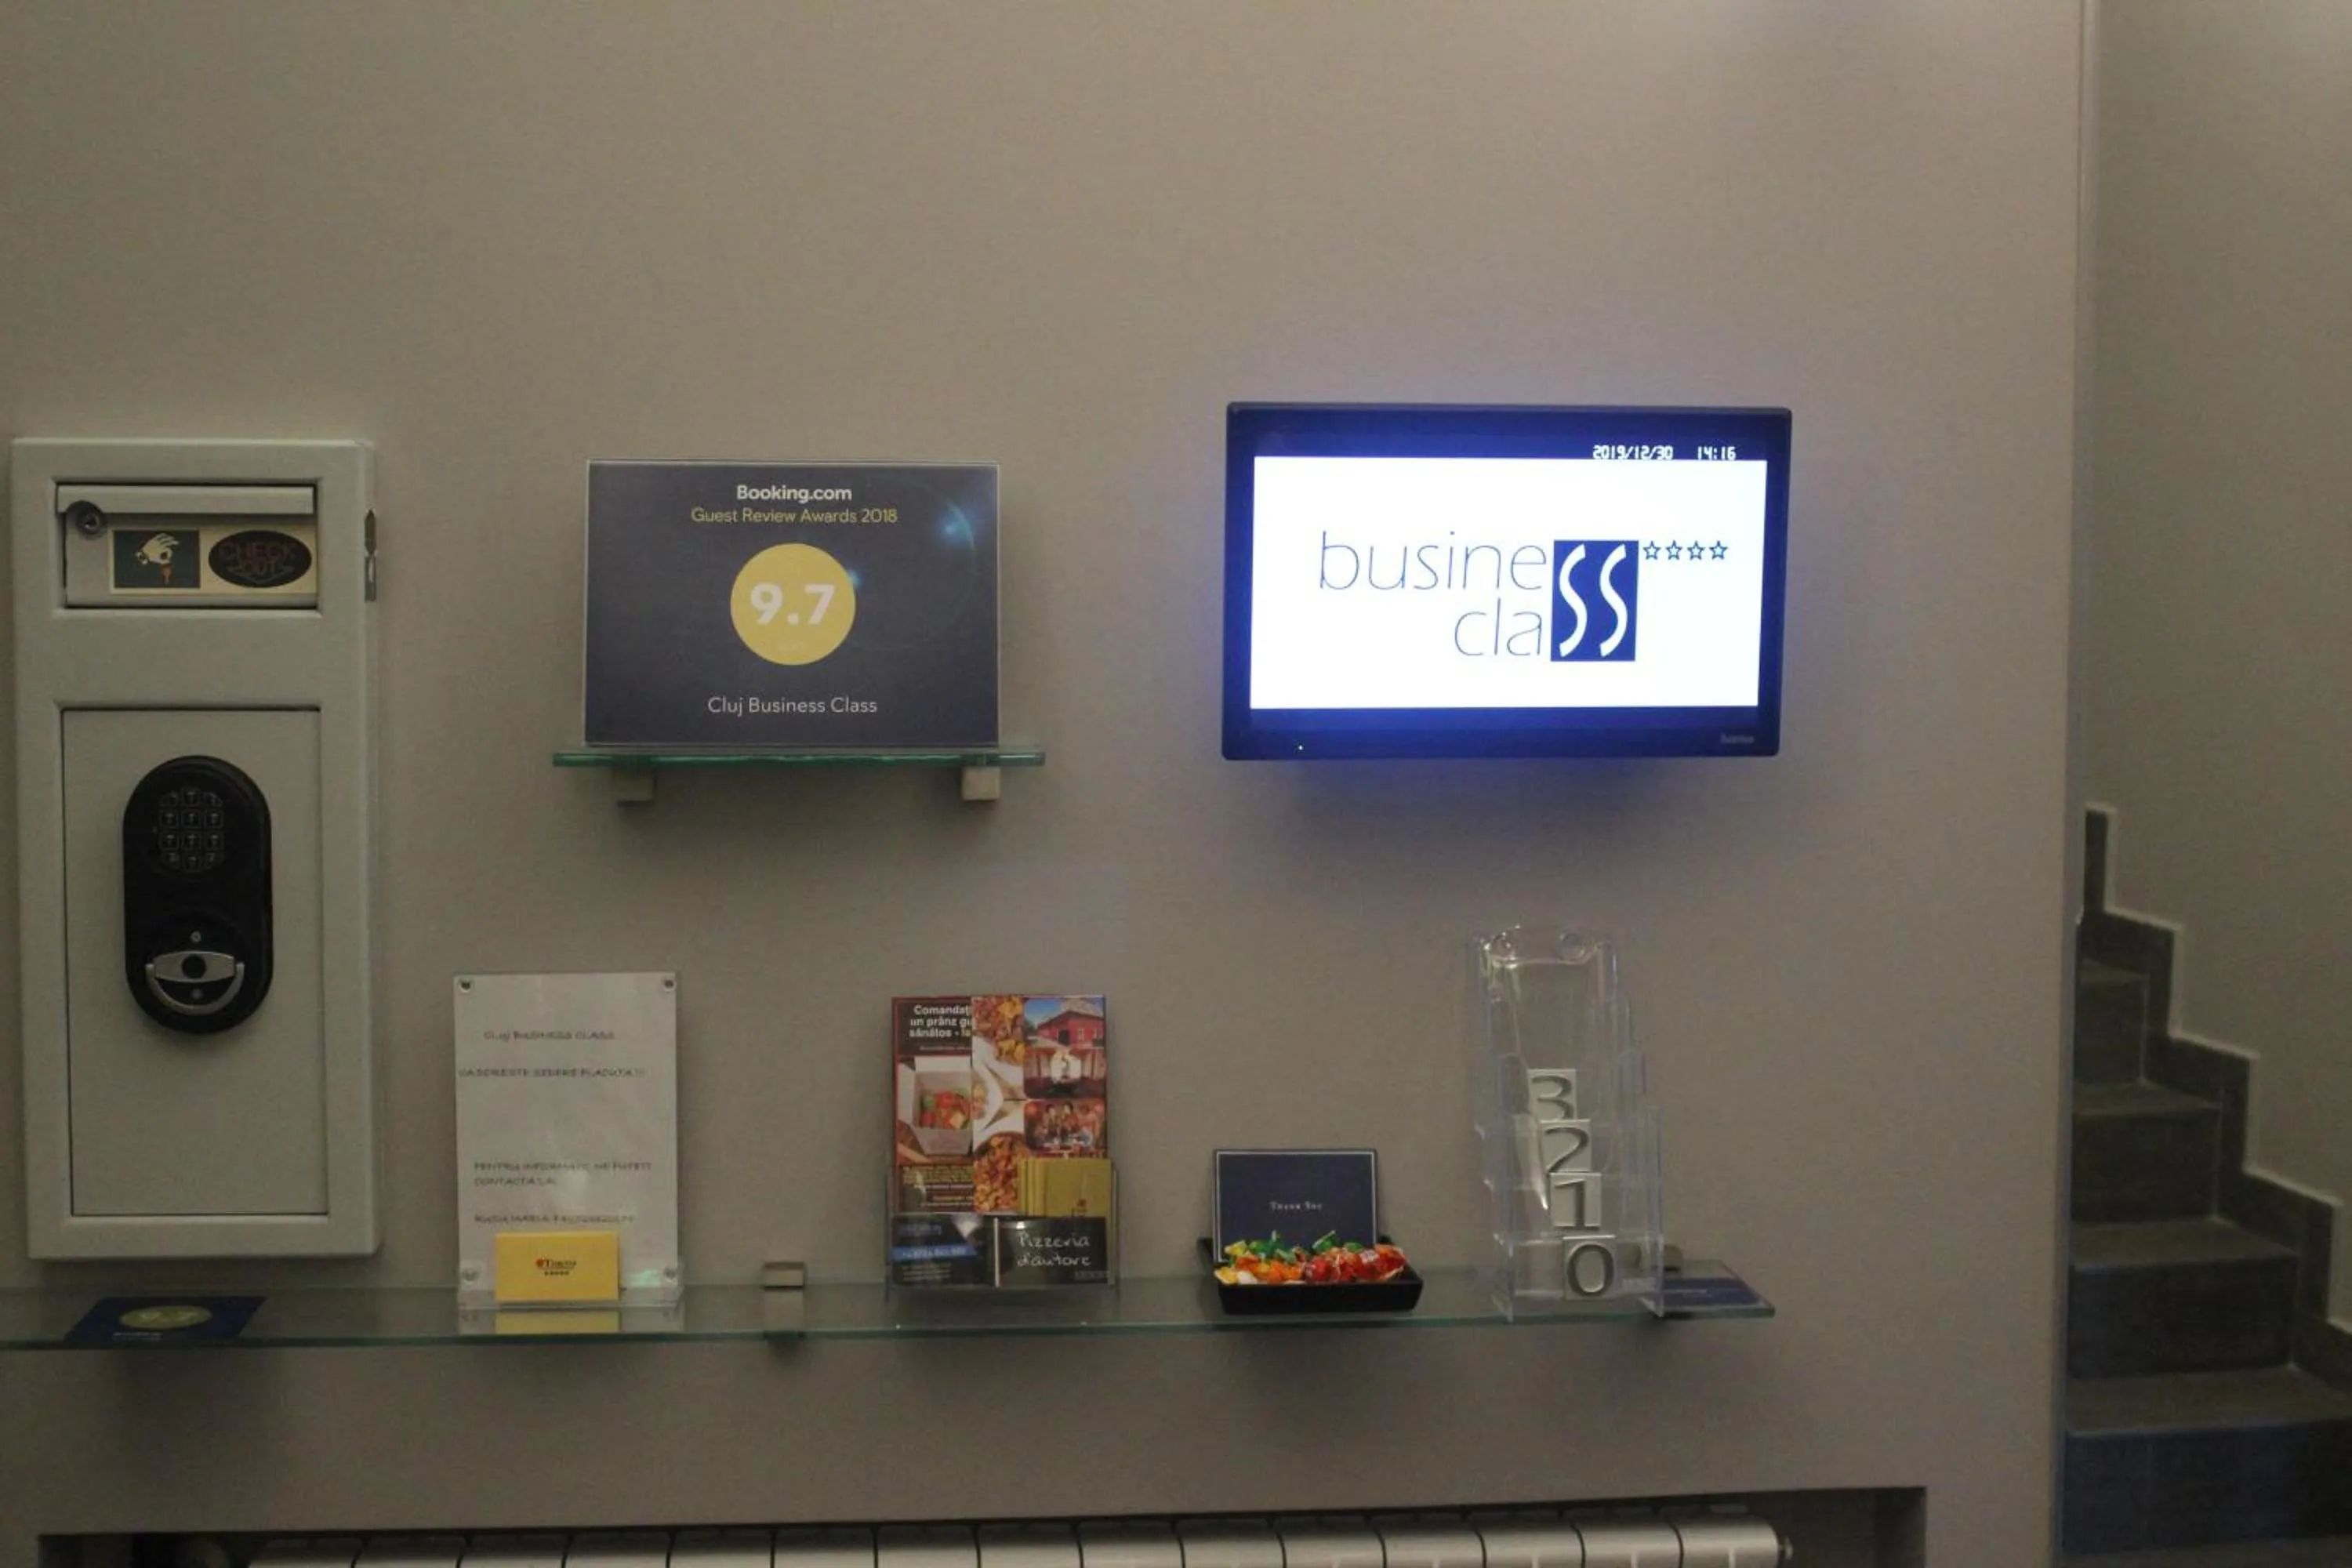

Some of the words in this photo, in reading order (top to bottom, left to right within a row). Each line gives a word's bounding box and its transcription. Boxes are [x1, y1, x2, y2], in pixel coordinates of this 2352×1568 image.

[1592, 445, 1673, 460] 2019/12/30
[1697, 445, 1737, 461] 14:16
[736, 485, 852, 503] Booking.com
[691, 507, 738, 523] Guest
[742, 508, 795, 523] Review
[800, 508, 858, 524] Awards
[861, 508, 898, 524] 2018
[750, 583, 837, 626] 9.7
[708, 696, 743, 717] Cluj
[749, 696, 826, 713] Business
[830, 696, 877, 713] Class
[1530, 1074, 1573, 1120] 3
[1544, 1126, 1591, 1174] 2
[1552, 1177, 1591, 1227] 1
[1019, 1230, 1091, 1248] Pizzeria
